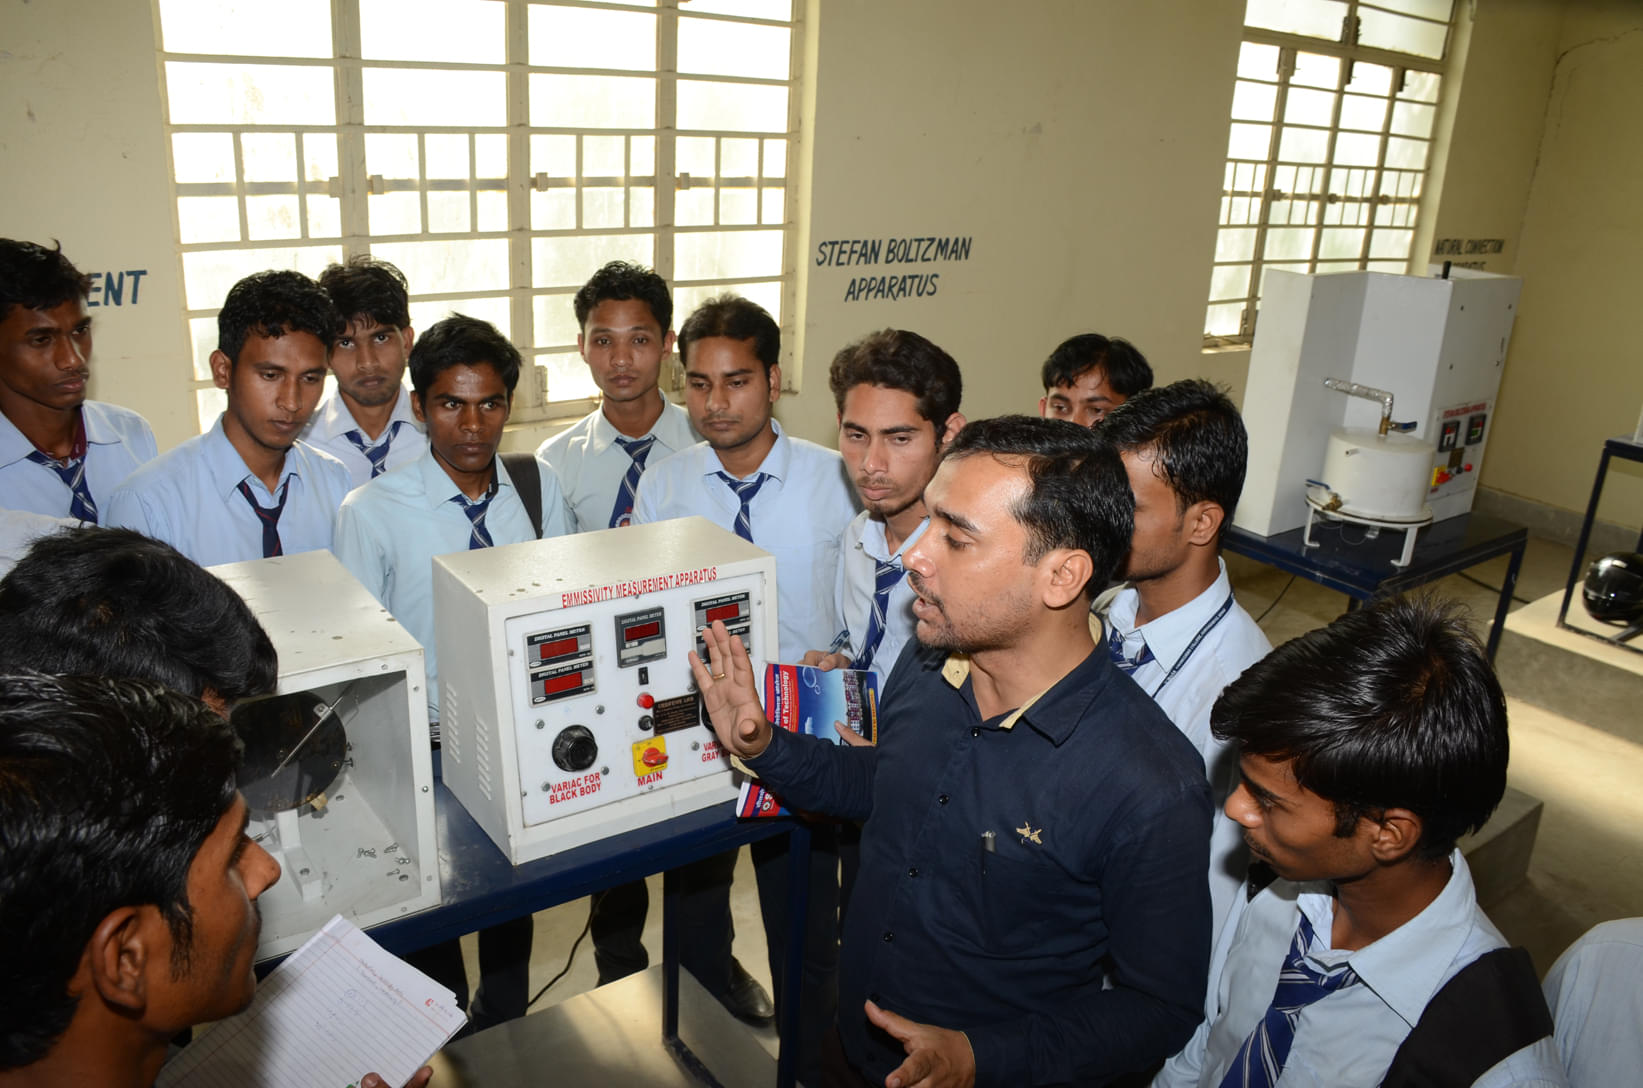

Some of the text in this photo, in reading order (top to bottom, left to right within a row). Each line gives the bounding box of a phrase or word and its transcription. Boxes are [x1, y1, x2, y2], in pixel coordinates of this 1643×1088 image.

[816, 236, 972, 267] STEFAN BOLTZMAN
[844, 273, 940, 302] APPARATUS
[562, 566, 718, 609] EMMISSIVITY MEASUREMENT APPARATUS
[782, 670, 790, 714] Technology
[702, 750, 719, 762] GRAY
[551, 771, 601, 794] VARIAC FOR
[637, 771, 663, 787] MAIN
[549, 781, 602, 805] BLACK BODY
